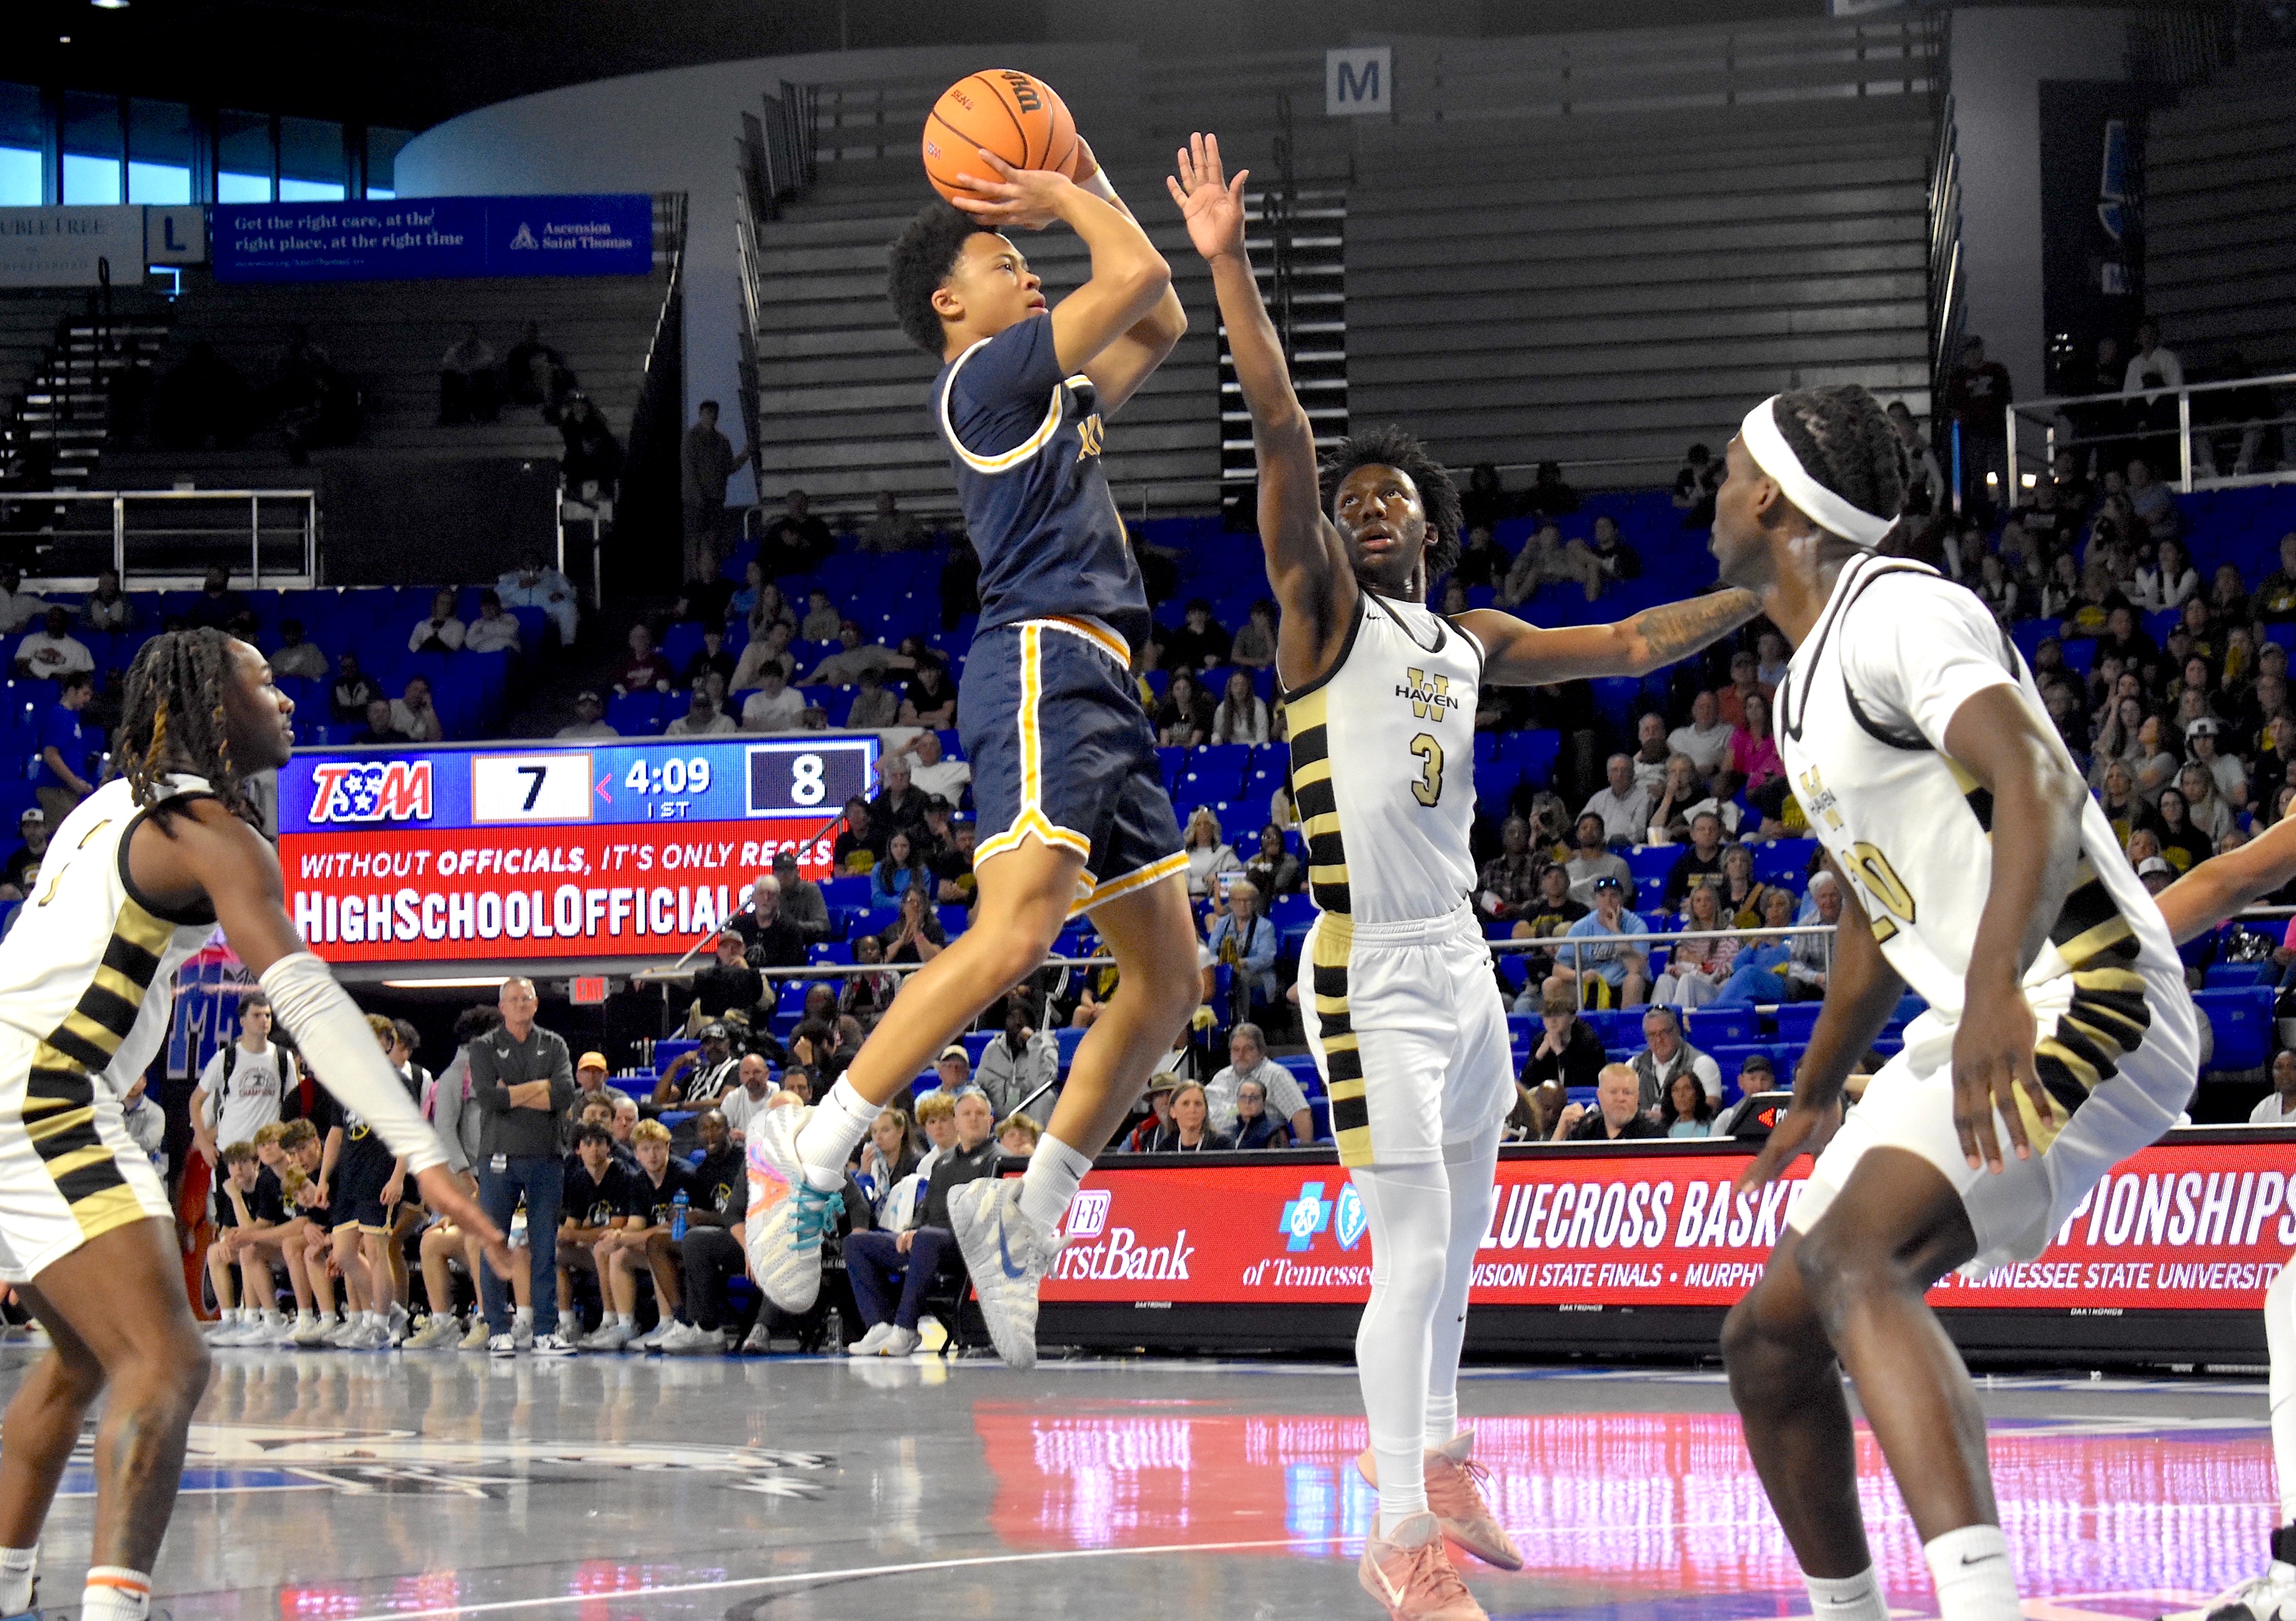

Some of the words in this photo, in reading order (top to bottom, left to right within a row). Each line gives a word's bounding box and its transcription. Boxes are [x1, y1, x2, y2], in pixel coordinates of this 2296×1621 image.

[1338, 61, 1379, 103] M
[165, 216, 186, 251] L
[235, 215, 262, 230] Get
[267, 215, 293, 230] the
[297, 213, 337, 232] right
[342, 216, 382, 229] care,
[386, 213, 402, 227] at
[406, 211, 434, 227] the
[543, 222, 611, 235] Ascension
[235, 236, 275, 253] right
[279, 235, 327, 253] place,
[331, 236, 347, 248] at
[352, 234, 378, 248] the
[382, 232, 421, 251] right
[426, 231, 464, 247] time
[542, 237, 577, 249] Saint
[579, 236, 633, 249] Thomas
[1395, 685, 1458, 710] HAVEN
[516, 765, 548, 811] 7
[625, 757, 710, 794] 4:09
[791, 753, 826, 805] 8
[1409, 732, 1444, 808] 3
[301, 849, 430, 879] WITHOUT
[437, 845, 591, 876] OFFICIALS,
[602, 843, 654, 871] IT'S
[662, 842, 734, 870] ONLY
[576, 977, 604, 1002] EXIT
[1072, 1199, 1105, 1230] FB
[1479, 1181, 1674, 1249] LUECROSS
[2046, 1171, 2296, 1246] PIONSHIPS
[1050, 1228, 1195, 1280] irstBank
[1243, 1258, 1270, 1286] of
[1469, 1263, 1529, 1287] VISION
[1530, 1263, 1539, 1287] I
[1539, 1263, 1596, 1287] STATE
[1598, 1263, 1663, 1287] FINALS
[2084, 1263, 2154, 1289] STATE
[2157, 1262, 2283, 1289] UNIVERSIT
